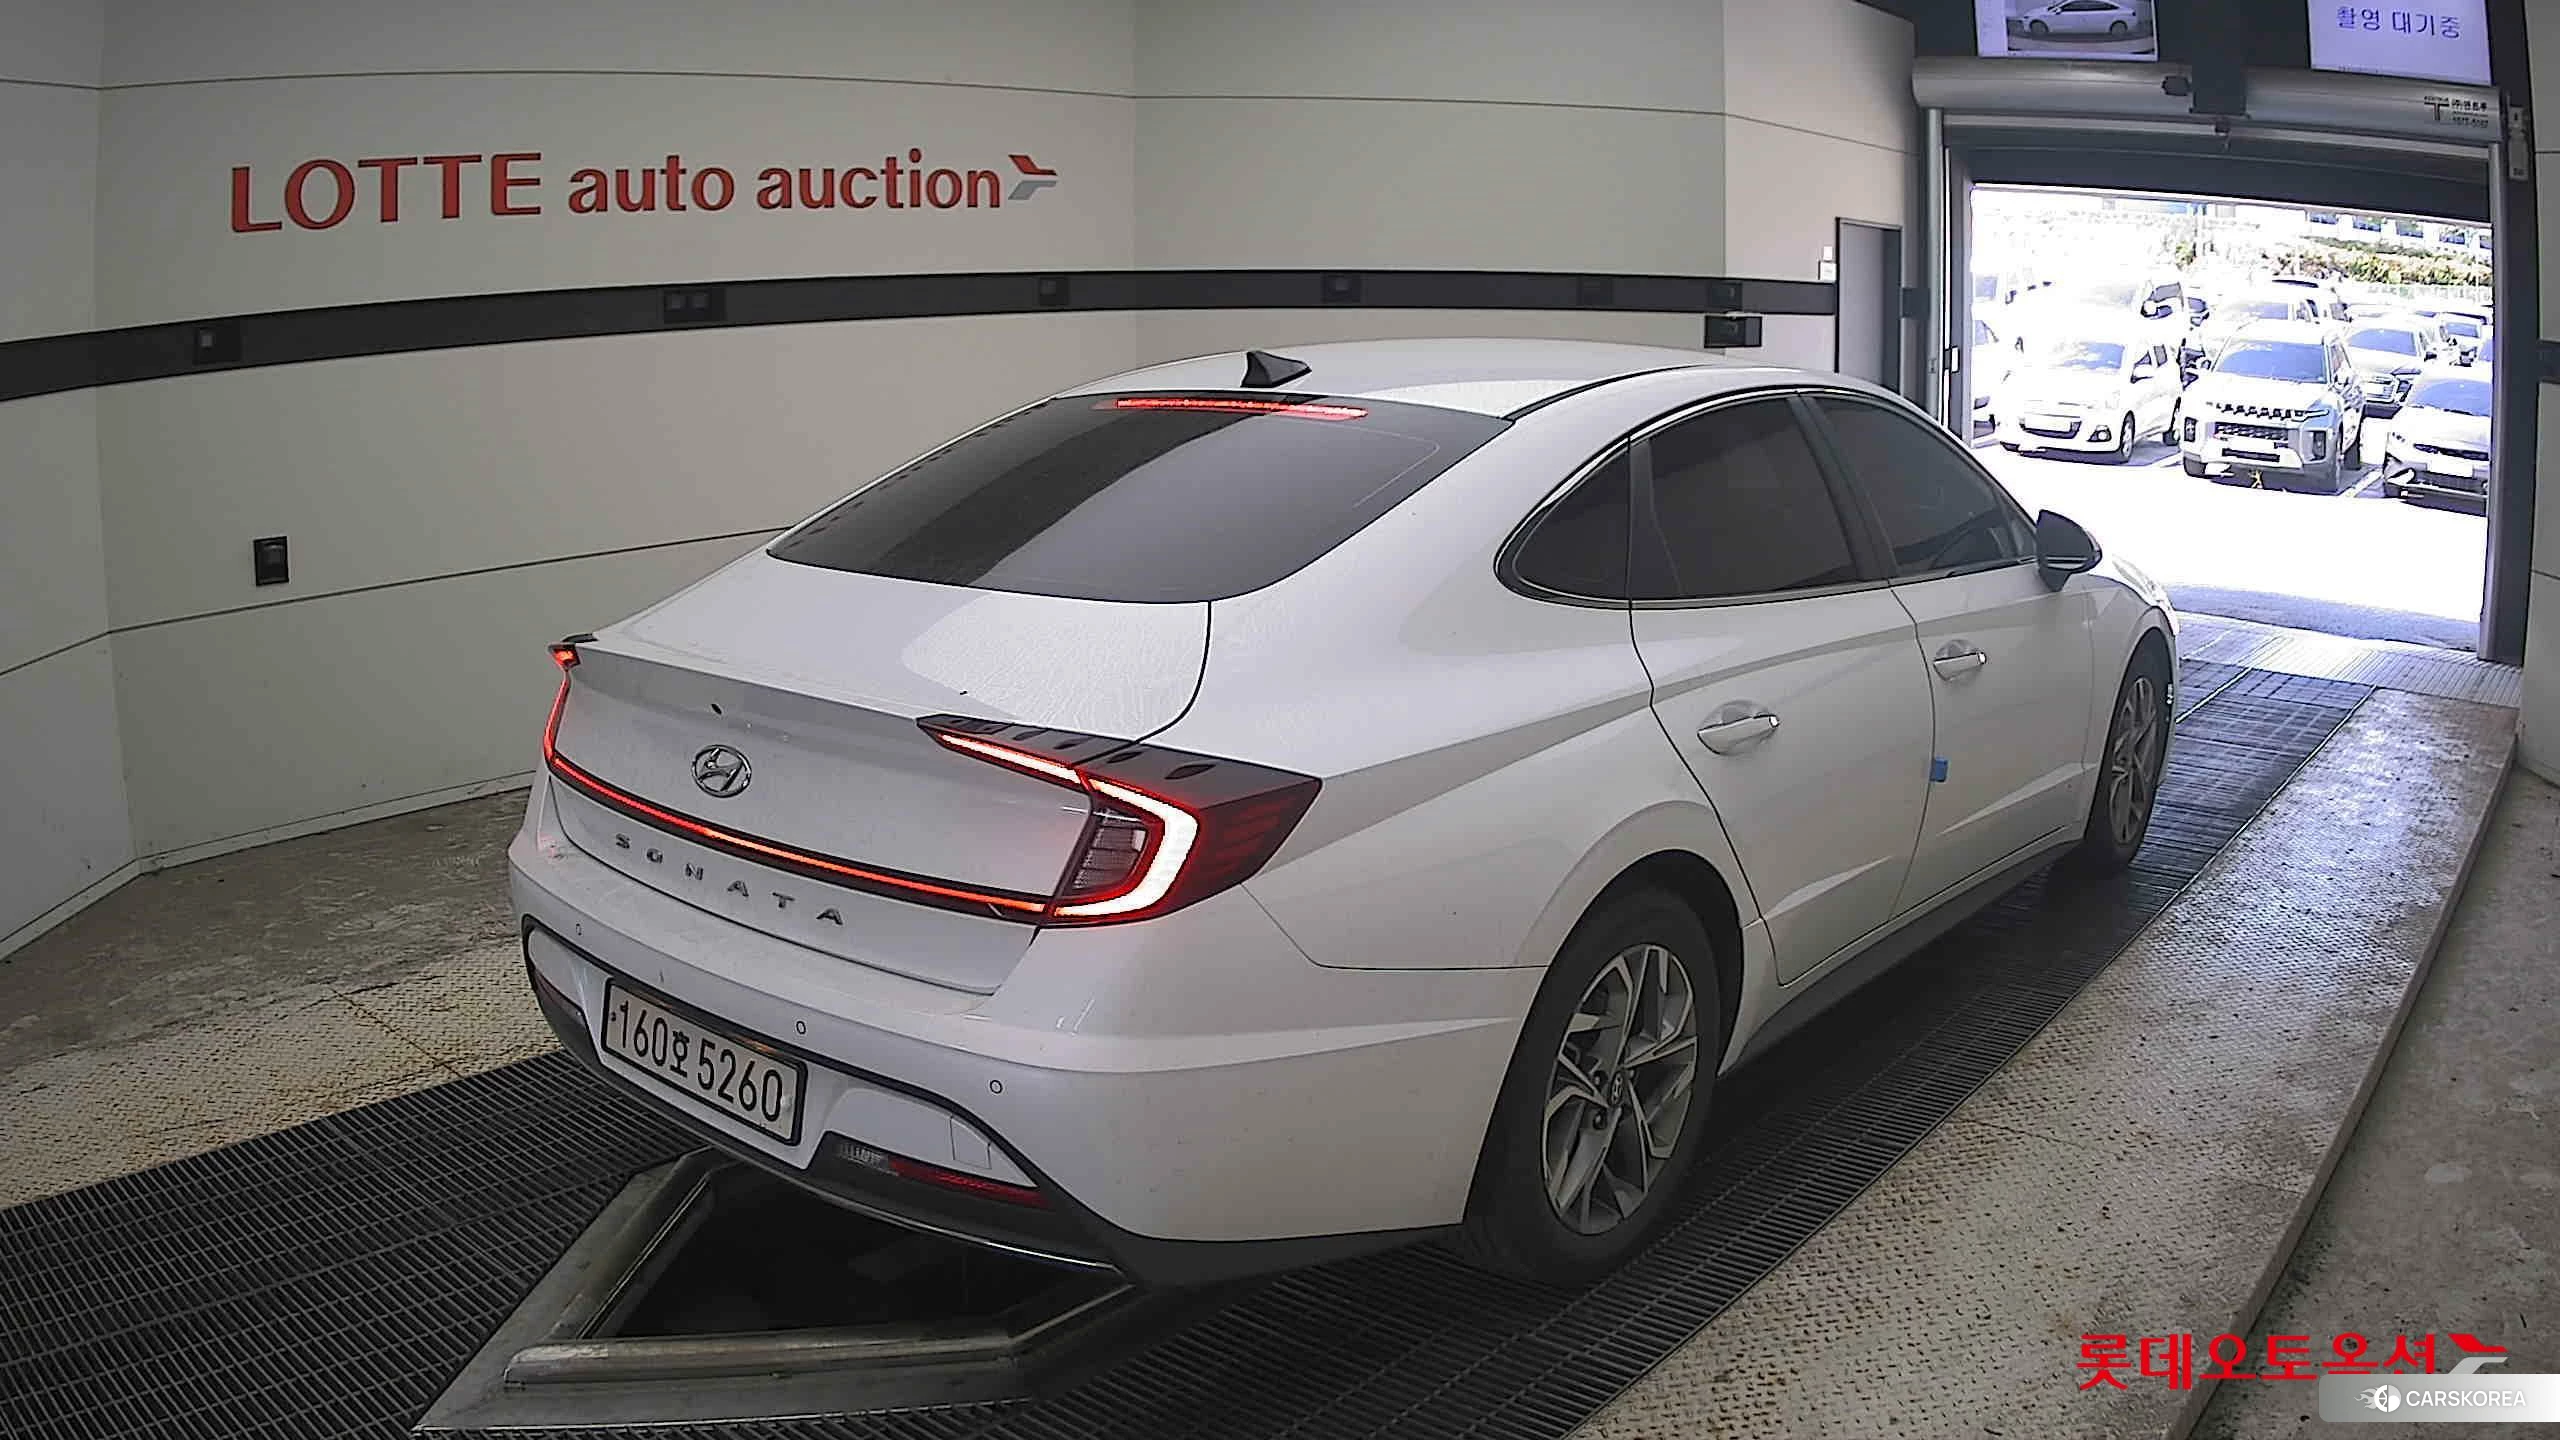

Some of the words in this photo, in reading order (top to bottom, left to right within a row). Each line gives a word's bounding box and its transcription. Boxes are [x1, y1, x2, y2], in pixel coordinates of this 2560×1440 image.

[2337, 6, 2381, 31] 촬영
[2391, 11, 2461, 39] 대기중
[230, 152, 542, 233] LOTTE
[568, 154, 736, 215] auto
[756, 147, 1001, 211] auction
[614, 832, 844, 926] SONATA
